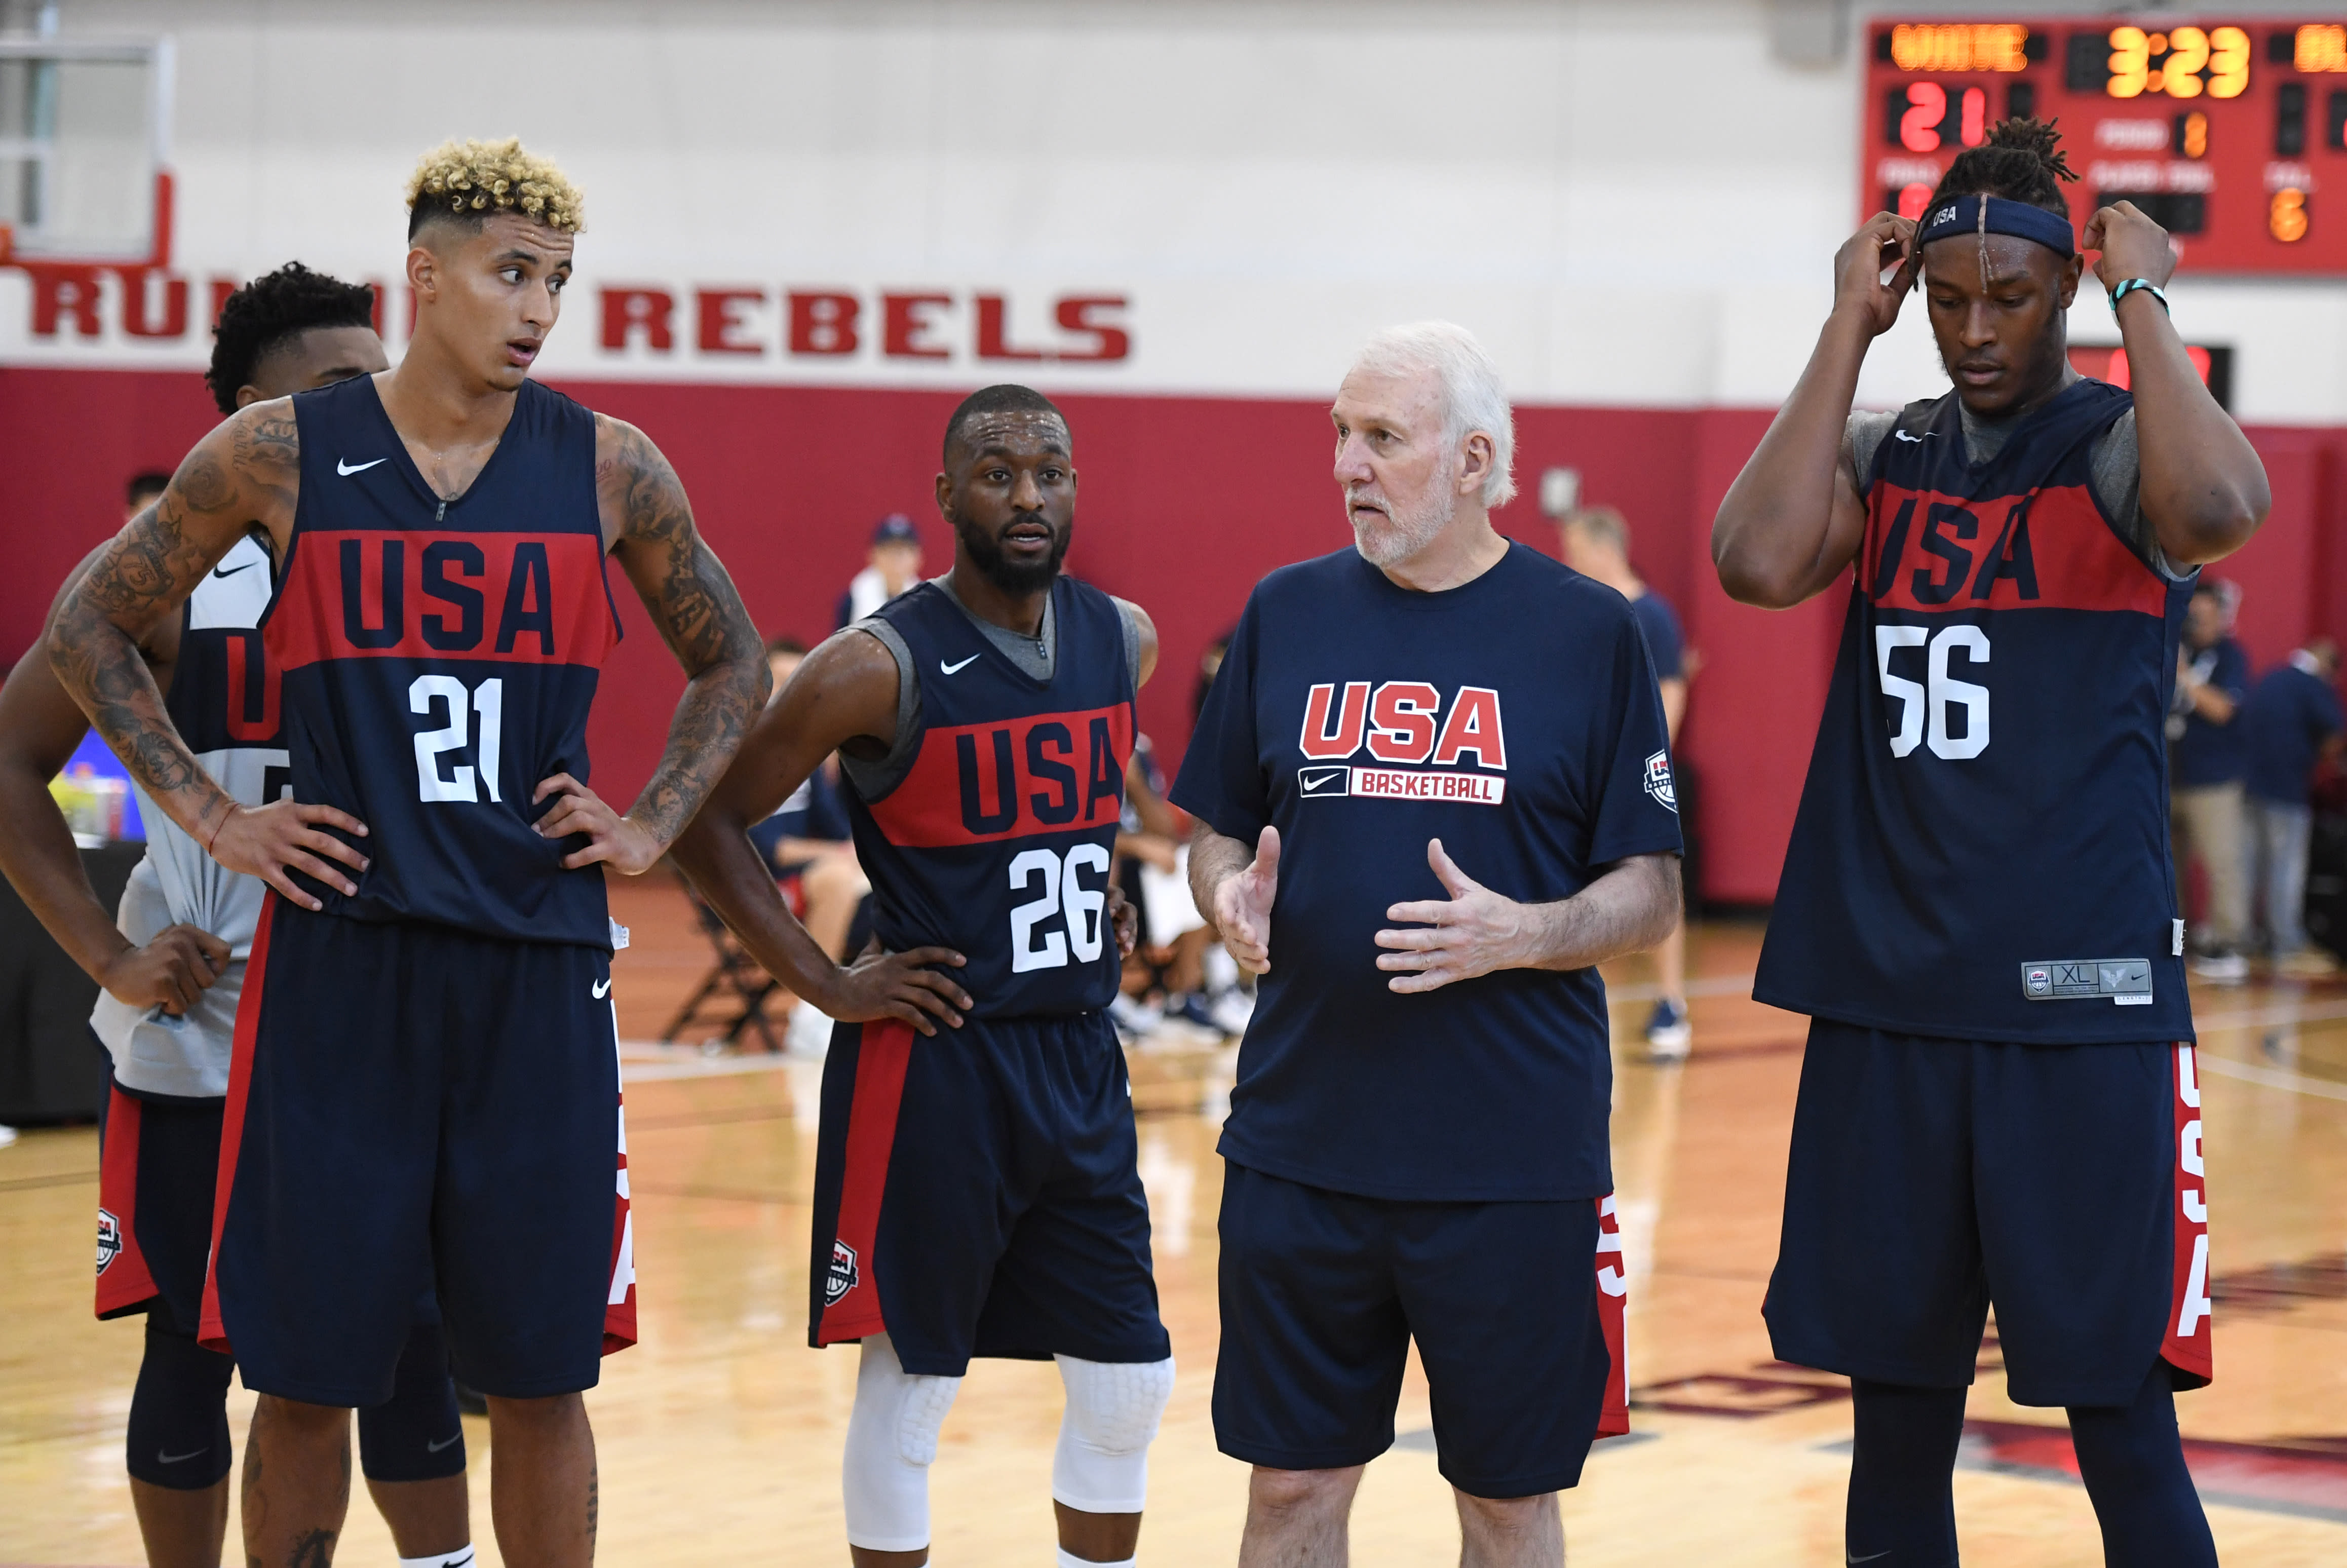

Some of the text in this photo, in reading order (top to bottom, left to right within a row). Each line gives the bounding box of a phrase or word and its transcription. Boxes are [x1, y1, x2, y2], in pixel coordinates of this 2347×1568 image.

[2106, 26, 2250, 98] 3:23
[1900, 82, 1985, 151] 21
[1933, 206, 1956, 227] USA
[597, 286, 1131, 361] REBELS
[339, 539, 555, 656] USA
[1299, 681, 1508, 771] USA
[1875, 625, 1990, 759] 56
[408, 675, 503, 802] 21
[956, 717, 1124, 835] USA
[1361, 772, 1493, 801] BASKETBALL
[1009, 843, 1110, 973] 26
[2061, 966, 2090, 984] XL
